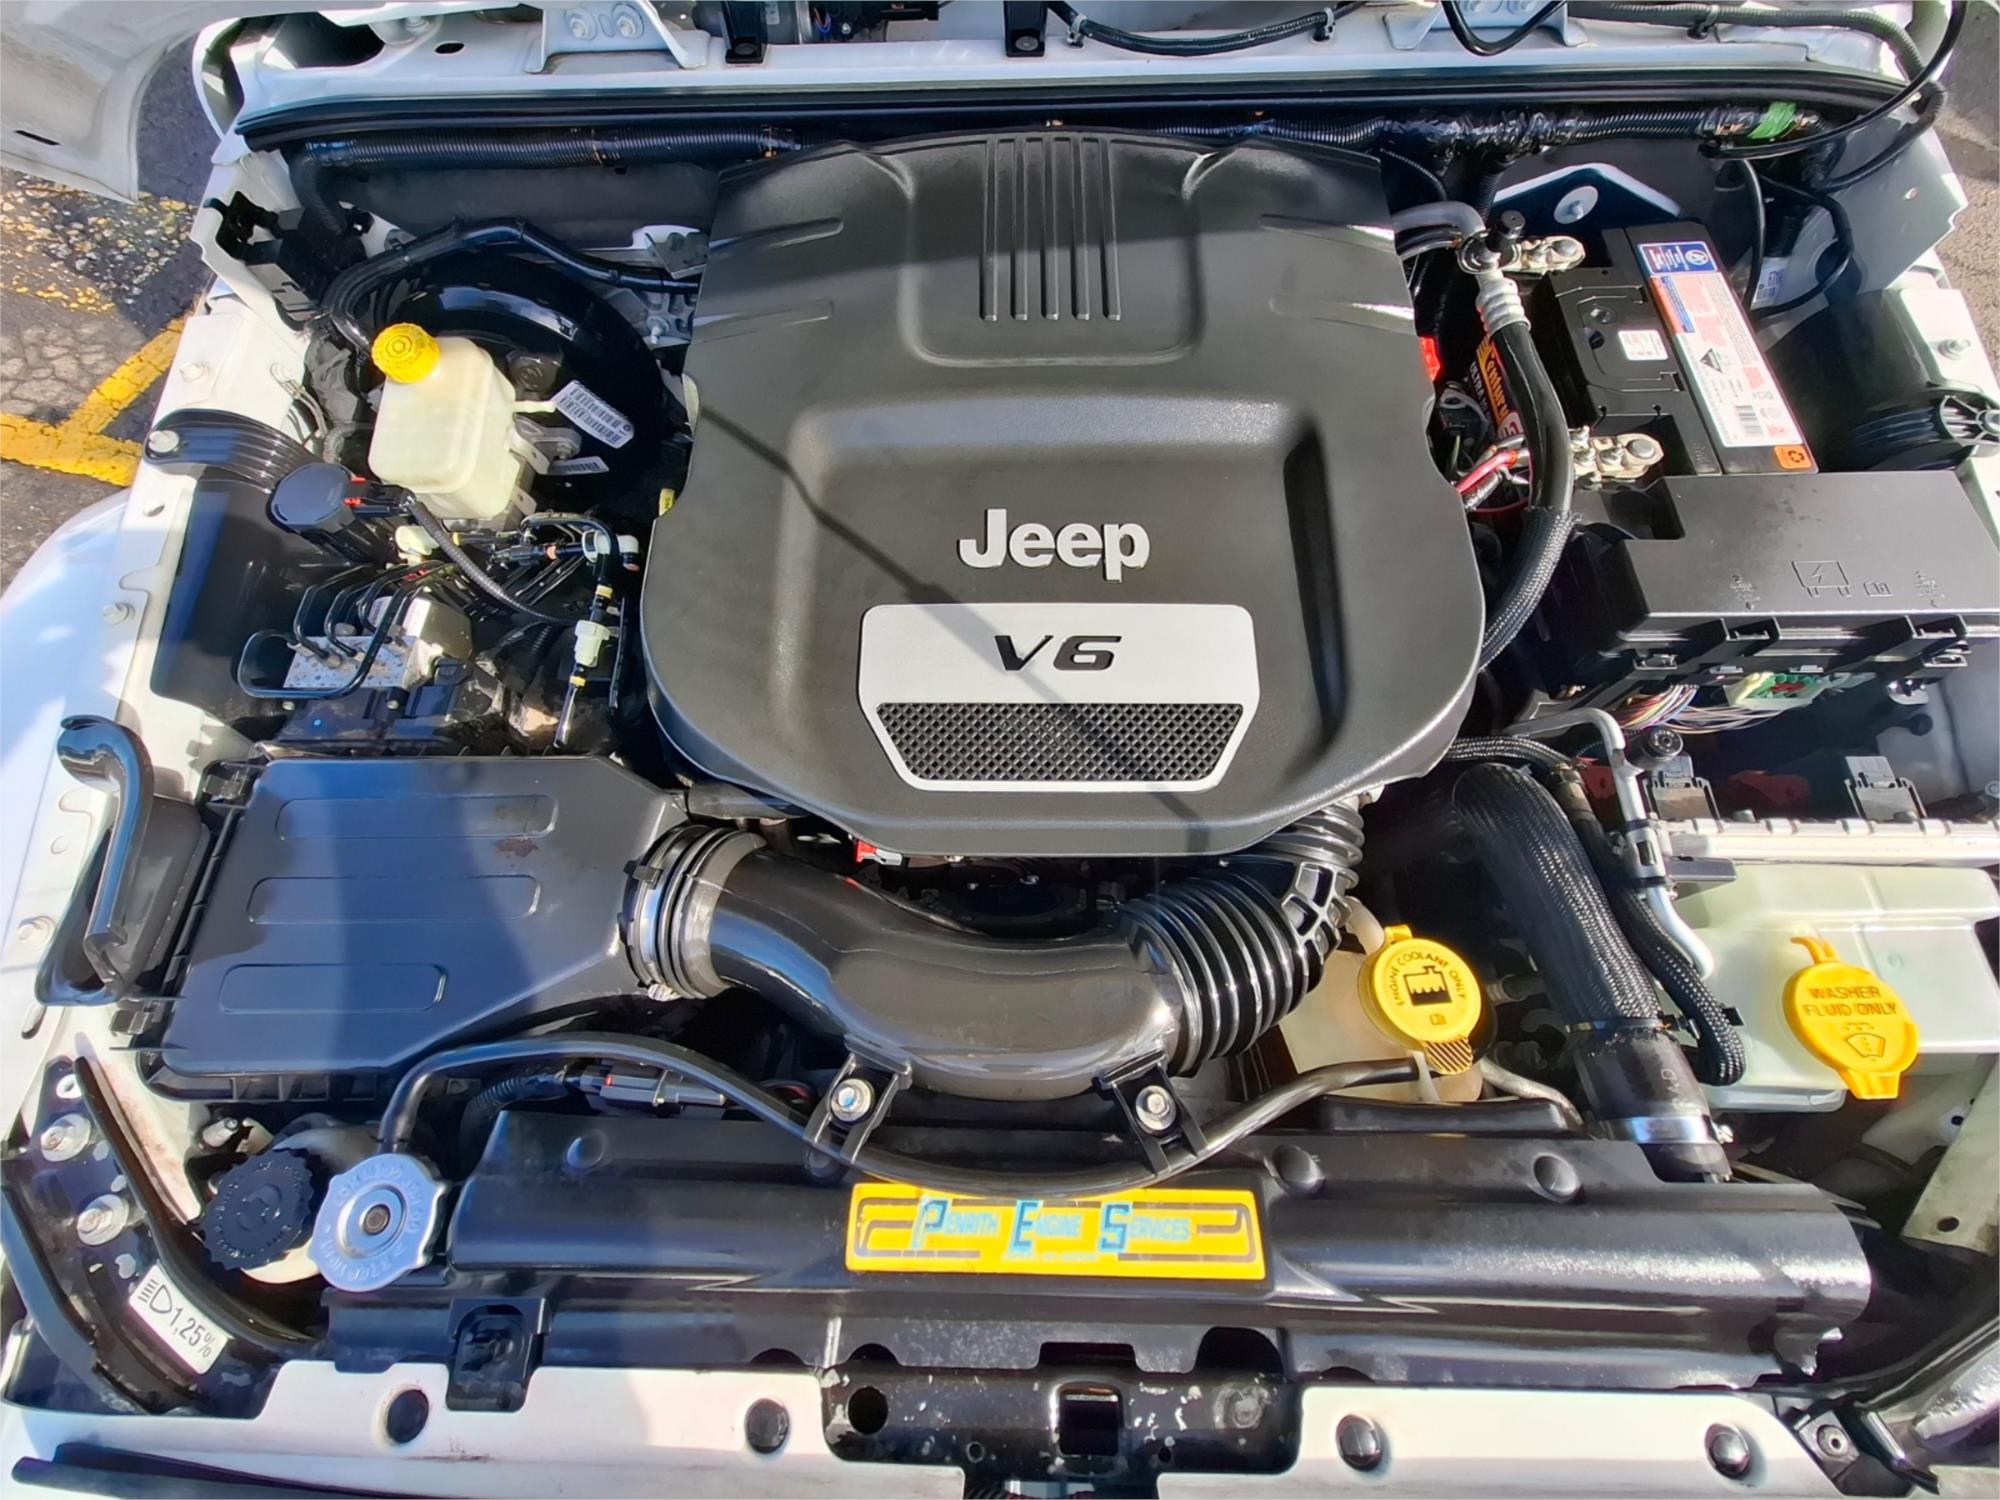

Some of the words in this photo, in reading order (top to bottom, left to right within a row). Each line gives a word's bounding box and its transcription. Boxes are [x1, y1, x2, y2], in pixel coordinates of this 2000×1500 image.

[958, 508, 1150, 582] Jeep
[994, 635, 1122, 671] V6
[1388, 966, 1405, 1006] ENGINE
[1397, 951, 1449, 969] COOLANT
[1450, 969, 1467, 1000] ONLY
[1807, 985, 1881, 999] WASHER
[1803, 1004, 1852, 1017] FLUID
[1857, 1002, 1898, 1016] ONLY
[1010, 1199, 1082, 1253] ENGINE
[1098, 1201, 1191, 1254] SERVICES
[170, 1307, 216, 1358] 1,25%
